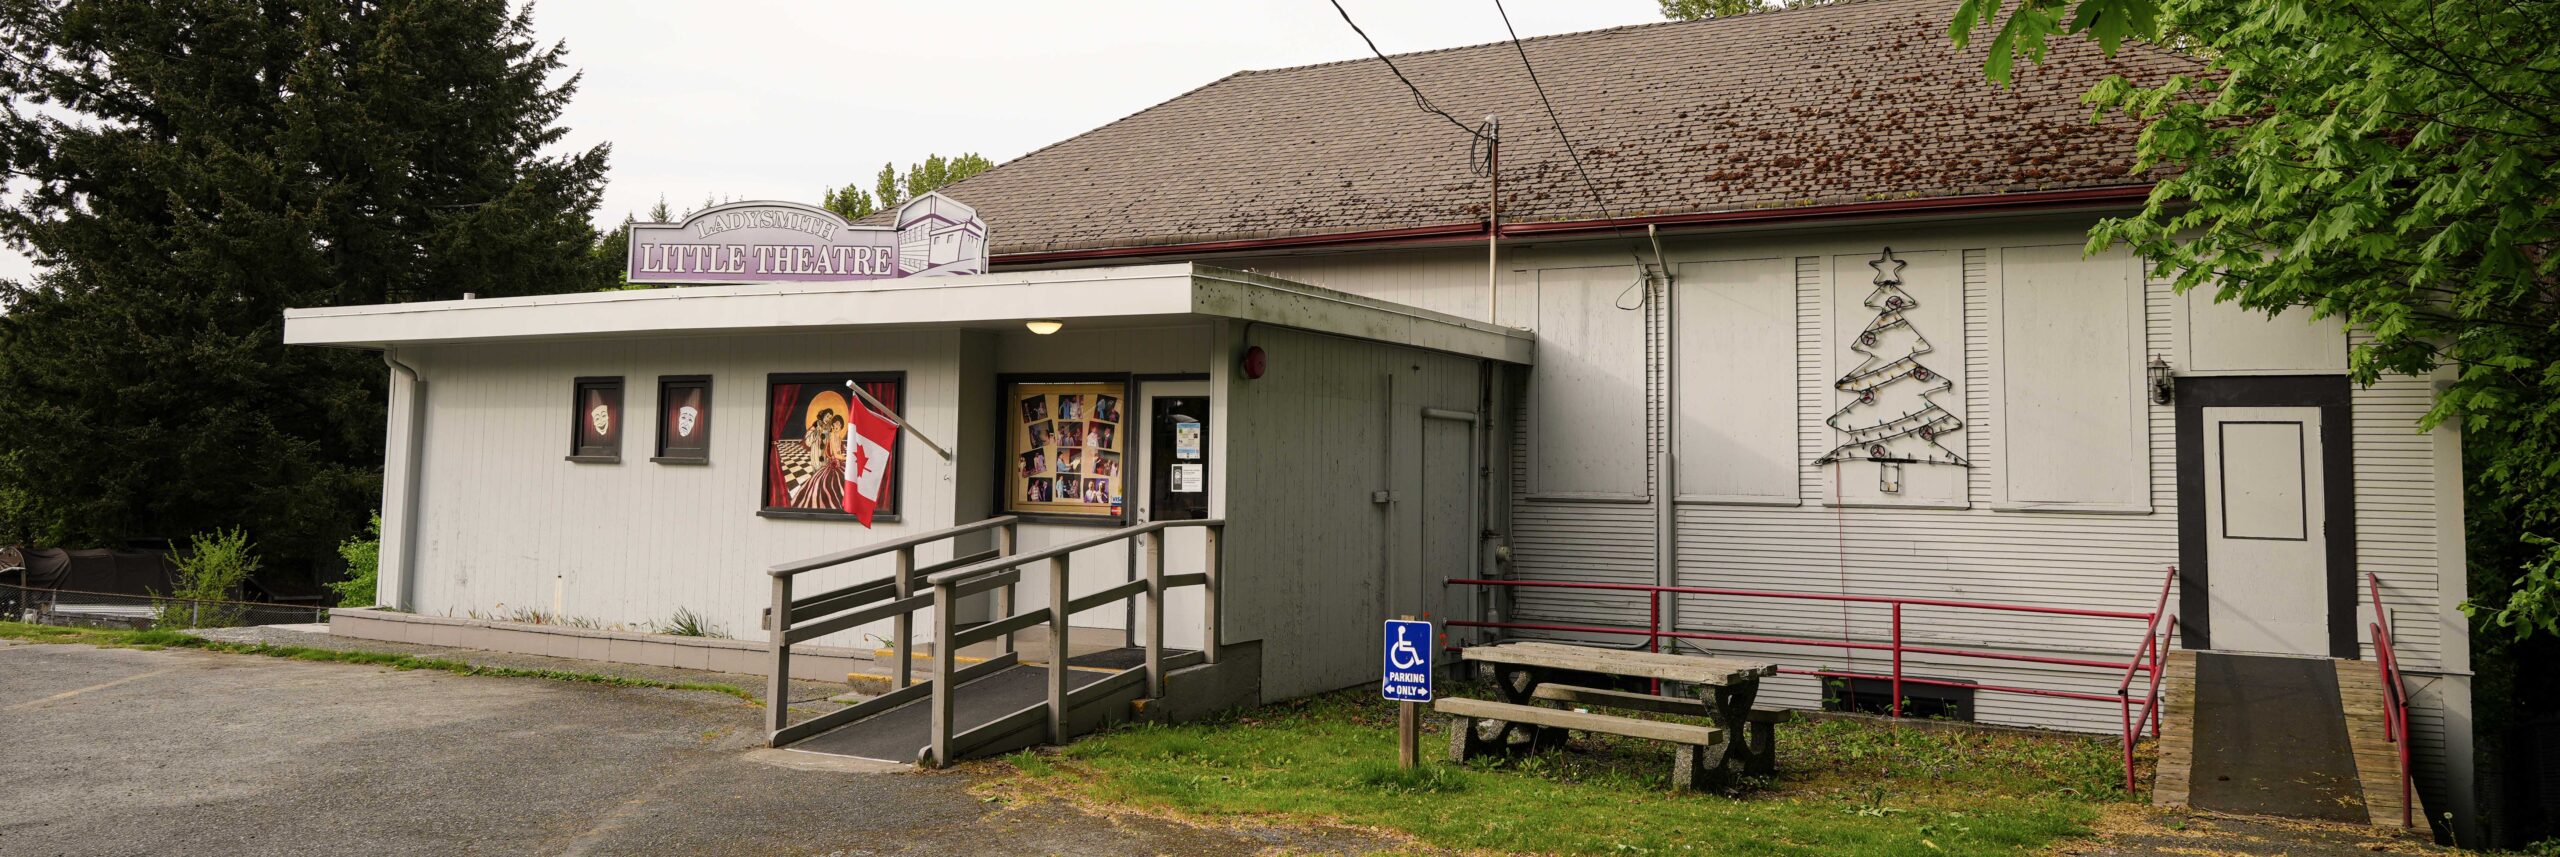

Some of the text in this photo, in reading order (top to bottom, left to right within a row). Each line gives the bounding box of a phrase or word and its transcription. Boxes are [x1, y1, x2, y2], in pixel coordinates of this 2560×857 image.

[696, 210, 838, 242] LADYSMITH
[639, 243, 893, 275] LITTLE THEATRE
[1389, 671, 1425, 684] PARKING
[1396, 685, 1417, 696] ONLY
